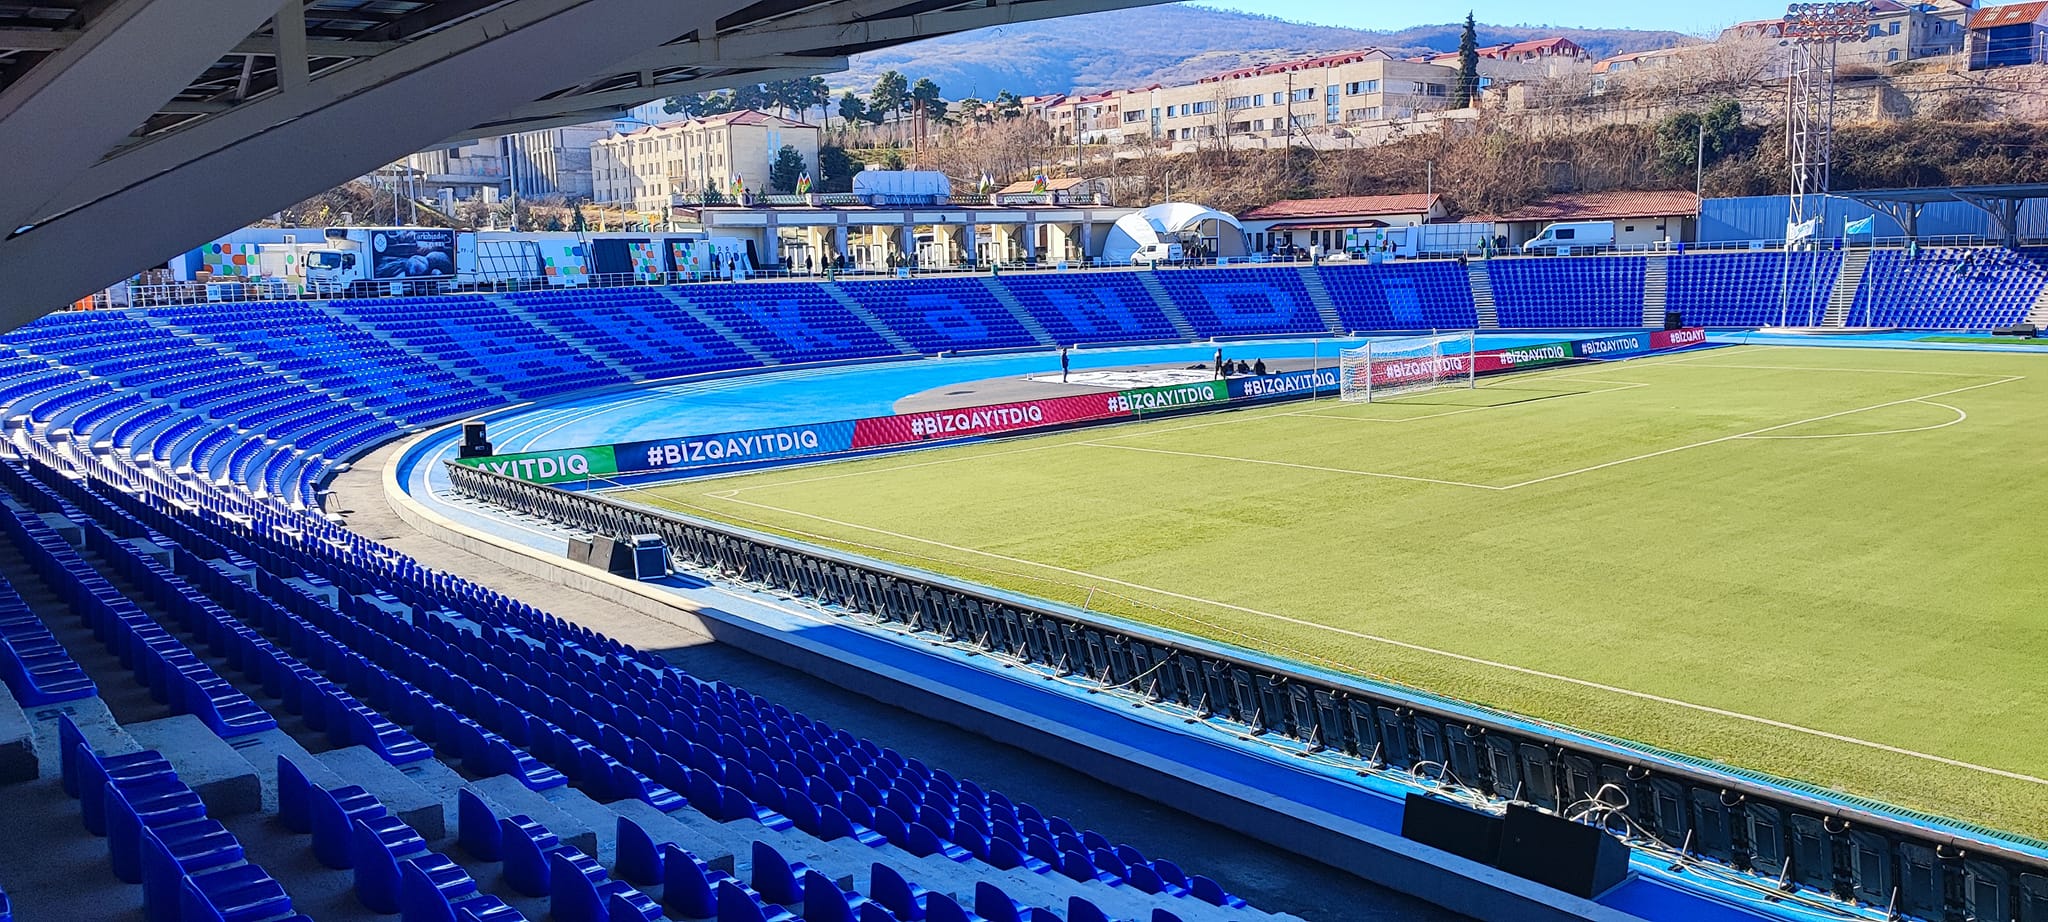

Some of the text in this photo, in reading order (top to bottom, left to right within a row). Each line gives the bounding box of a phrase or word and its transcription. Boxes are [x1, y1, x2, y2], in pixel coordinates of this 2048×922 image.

[1581, 338, 1639, 355] #BİZQAYITDIQ
[1244, 372, 1336, 396] #BİZQAYITDIQ
[1108, 386, 1215, 413] #BİZQAYITDIQ
[911, 406, 1043, 436] #BİZQAYITDIQ
[647, 430, 819, 467] #BİZQAYITDIQ
